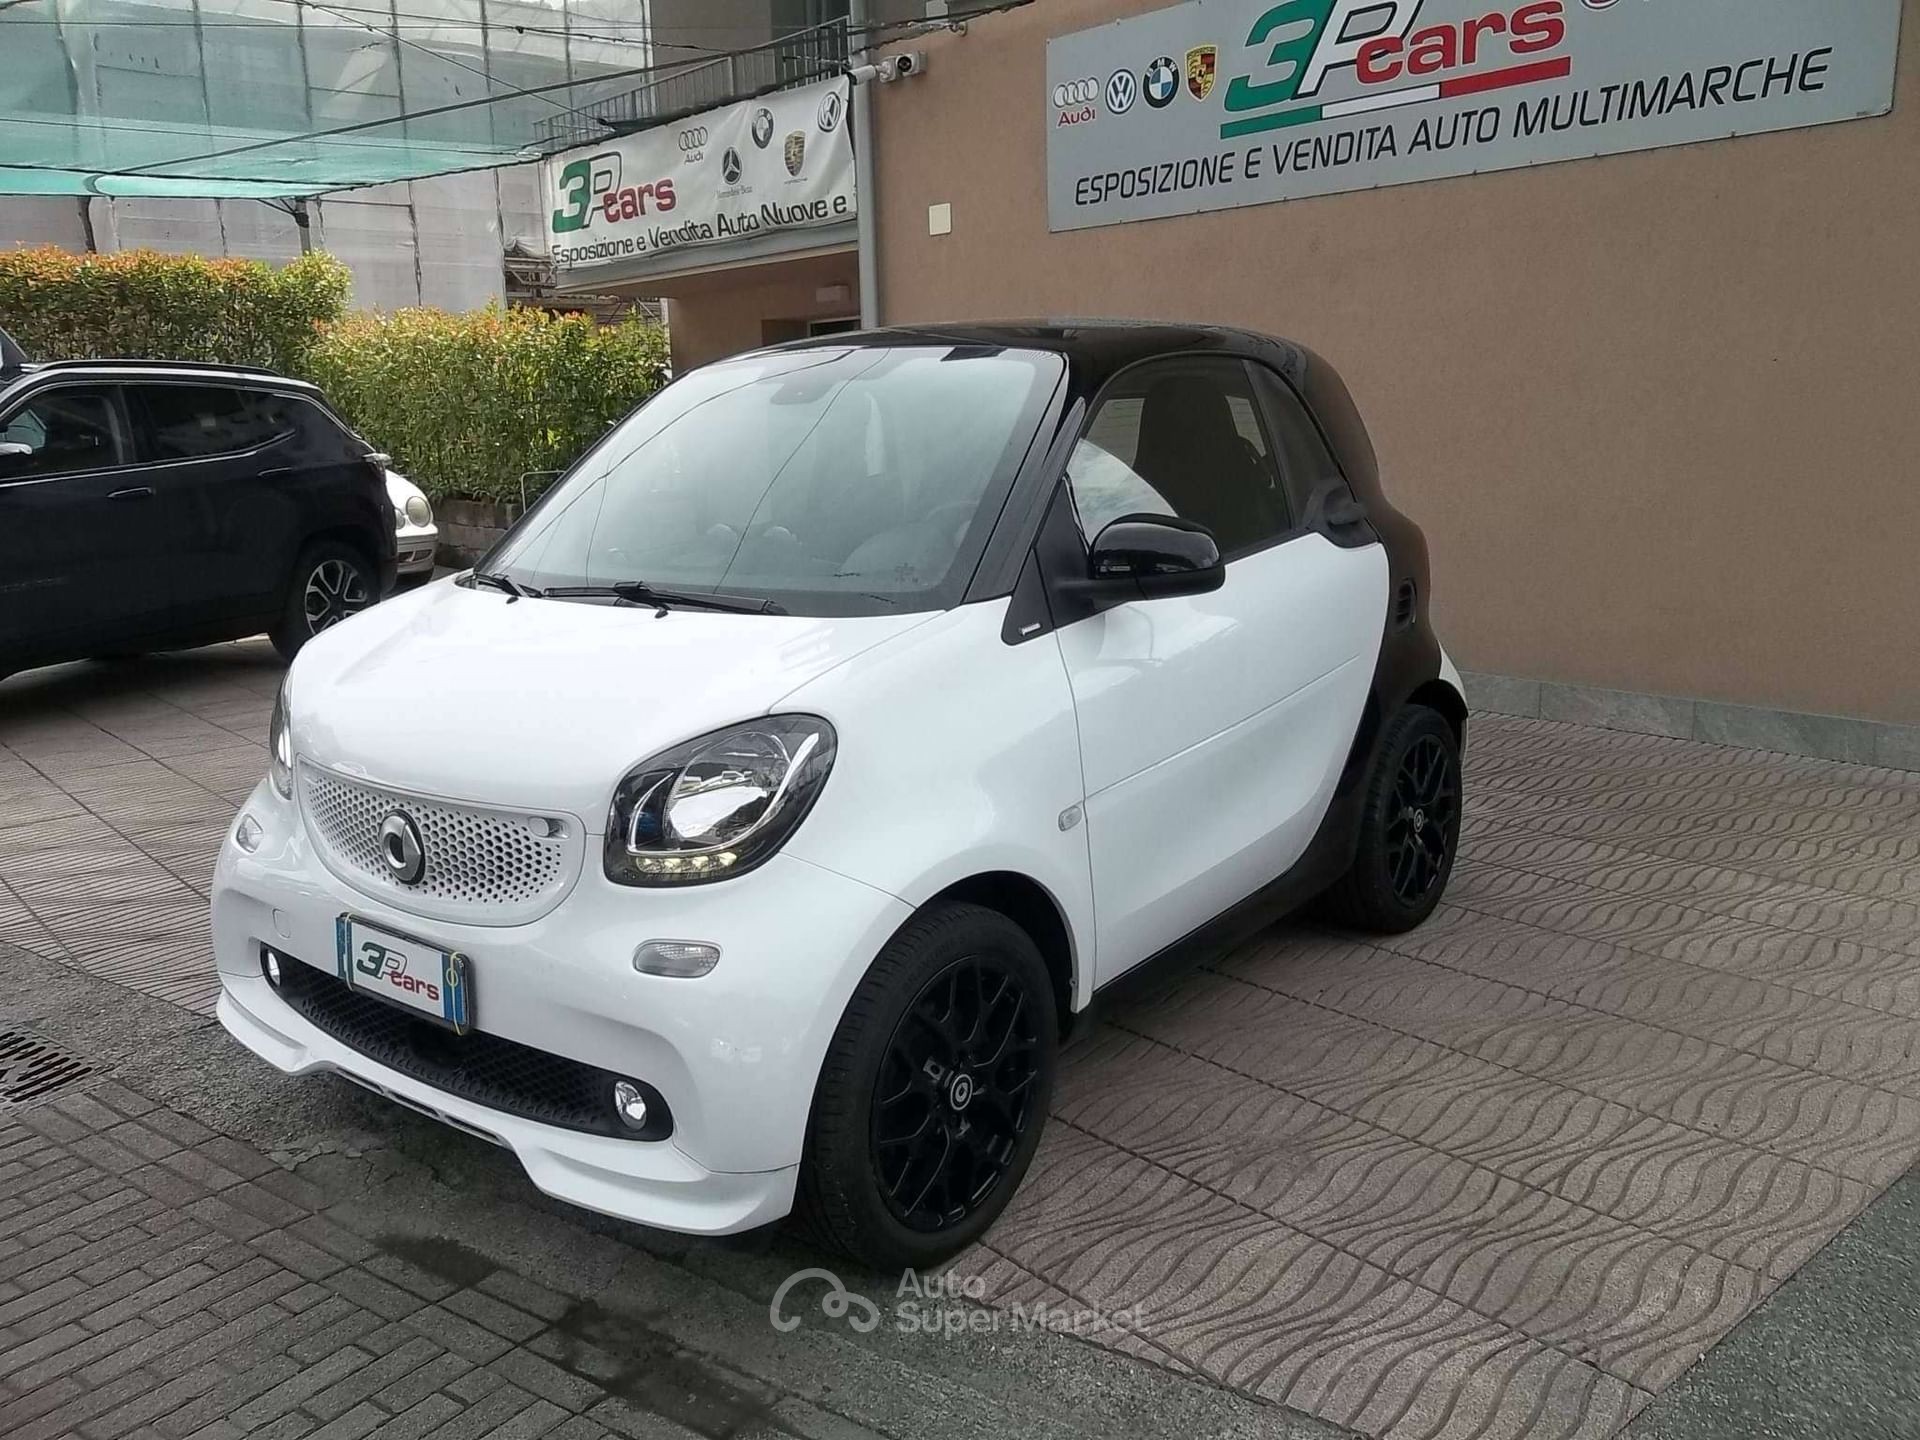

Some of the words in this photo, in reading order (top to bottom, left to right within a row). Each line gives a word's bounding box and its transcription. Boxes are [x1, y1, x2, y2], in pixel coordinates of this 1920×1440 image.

[1057, 107, 1097, 127] Audi
[1075, 151, 1235, 206] ESPOSIZIONE
[1244, 147, 1262, 179] E
[1273, 124, 1398, 172] VENDITA
[1407, 107, 1501, 155] AUTO
[1513, 46, 1833, 139] MULTIMARCHE
[551, 236, 634, 265] Esposizione
[636, 235, 647, 252] e
[647, 220, 713, 249] Vendita
[717, 212, 761, 236] Auto
[760, 200, 829, 227] Nuove
[832, 195, 848, 214] e
